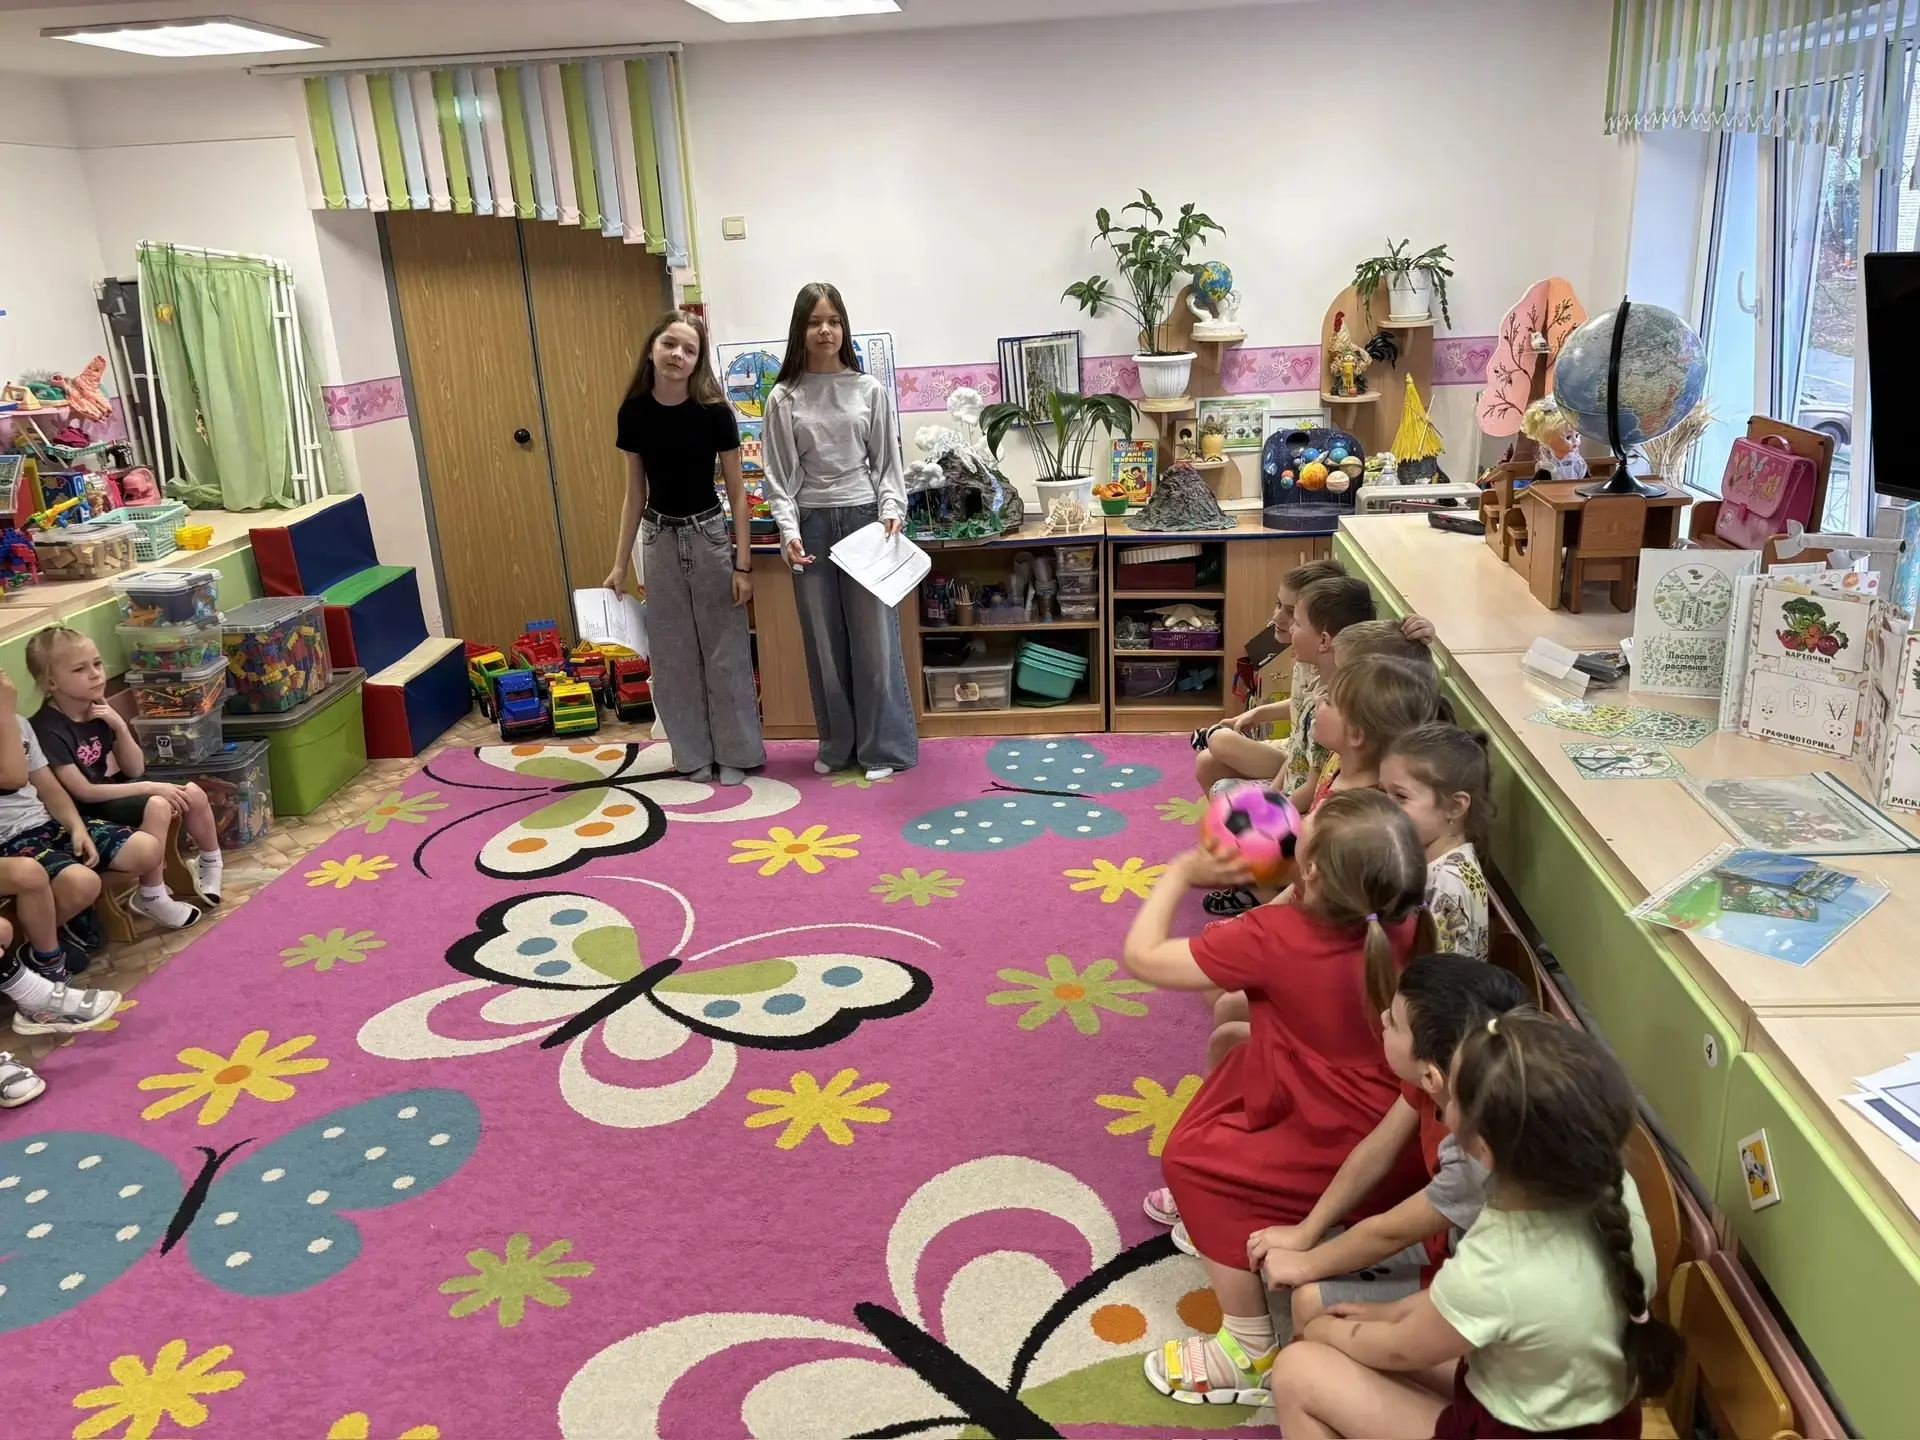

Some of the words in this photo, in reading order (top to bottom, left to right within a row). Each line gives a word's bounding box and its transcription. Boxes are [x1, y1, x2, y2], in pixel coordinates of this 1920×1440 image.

[1098, 360, 1112, 368] girl
[931, 369, 945, 377] girl
[1668, 651, 1707, 662] Паспорт
[1785, 650, 1831, 665] КАРТОЧКИ
[1664, 663, 1708, 672] растения
[1761, 728, 1836, 751] ГРАФОМОТОРИКА
[1891, 796, 1920, 808] РАСК
[1706, 1042, 1713, 1060] 4
